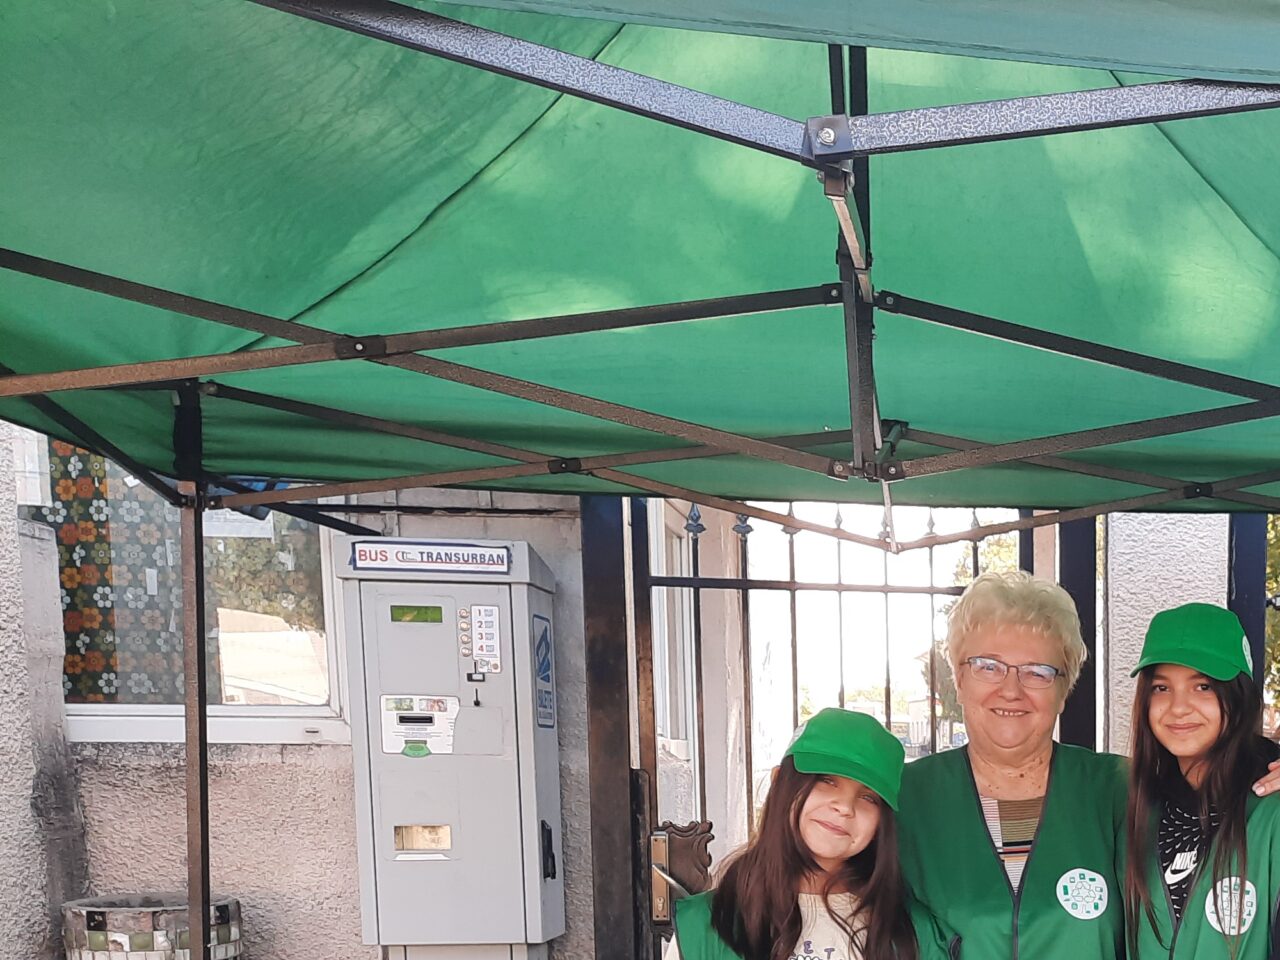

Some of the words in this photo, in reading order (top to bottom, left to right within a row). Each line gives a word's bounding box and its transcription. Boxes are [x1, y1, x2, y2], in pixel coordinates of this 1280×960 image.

[358, 550, 388, 562] BUS
[418, 551, 505, 565] TRANSURBAN
[1171, 850, 1198, 871] NIKE
